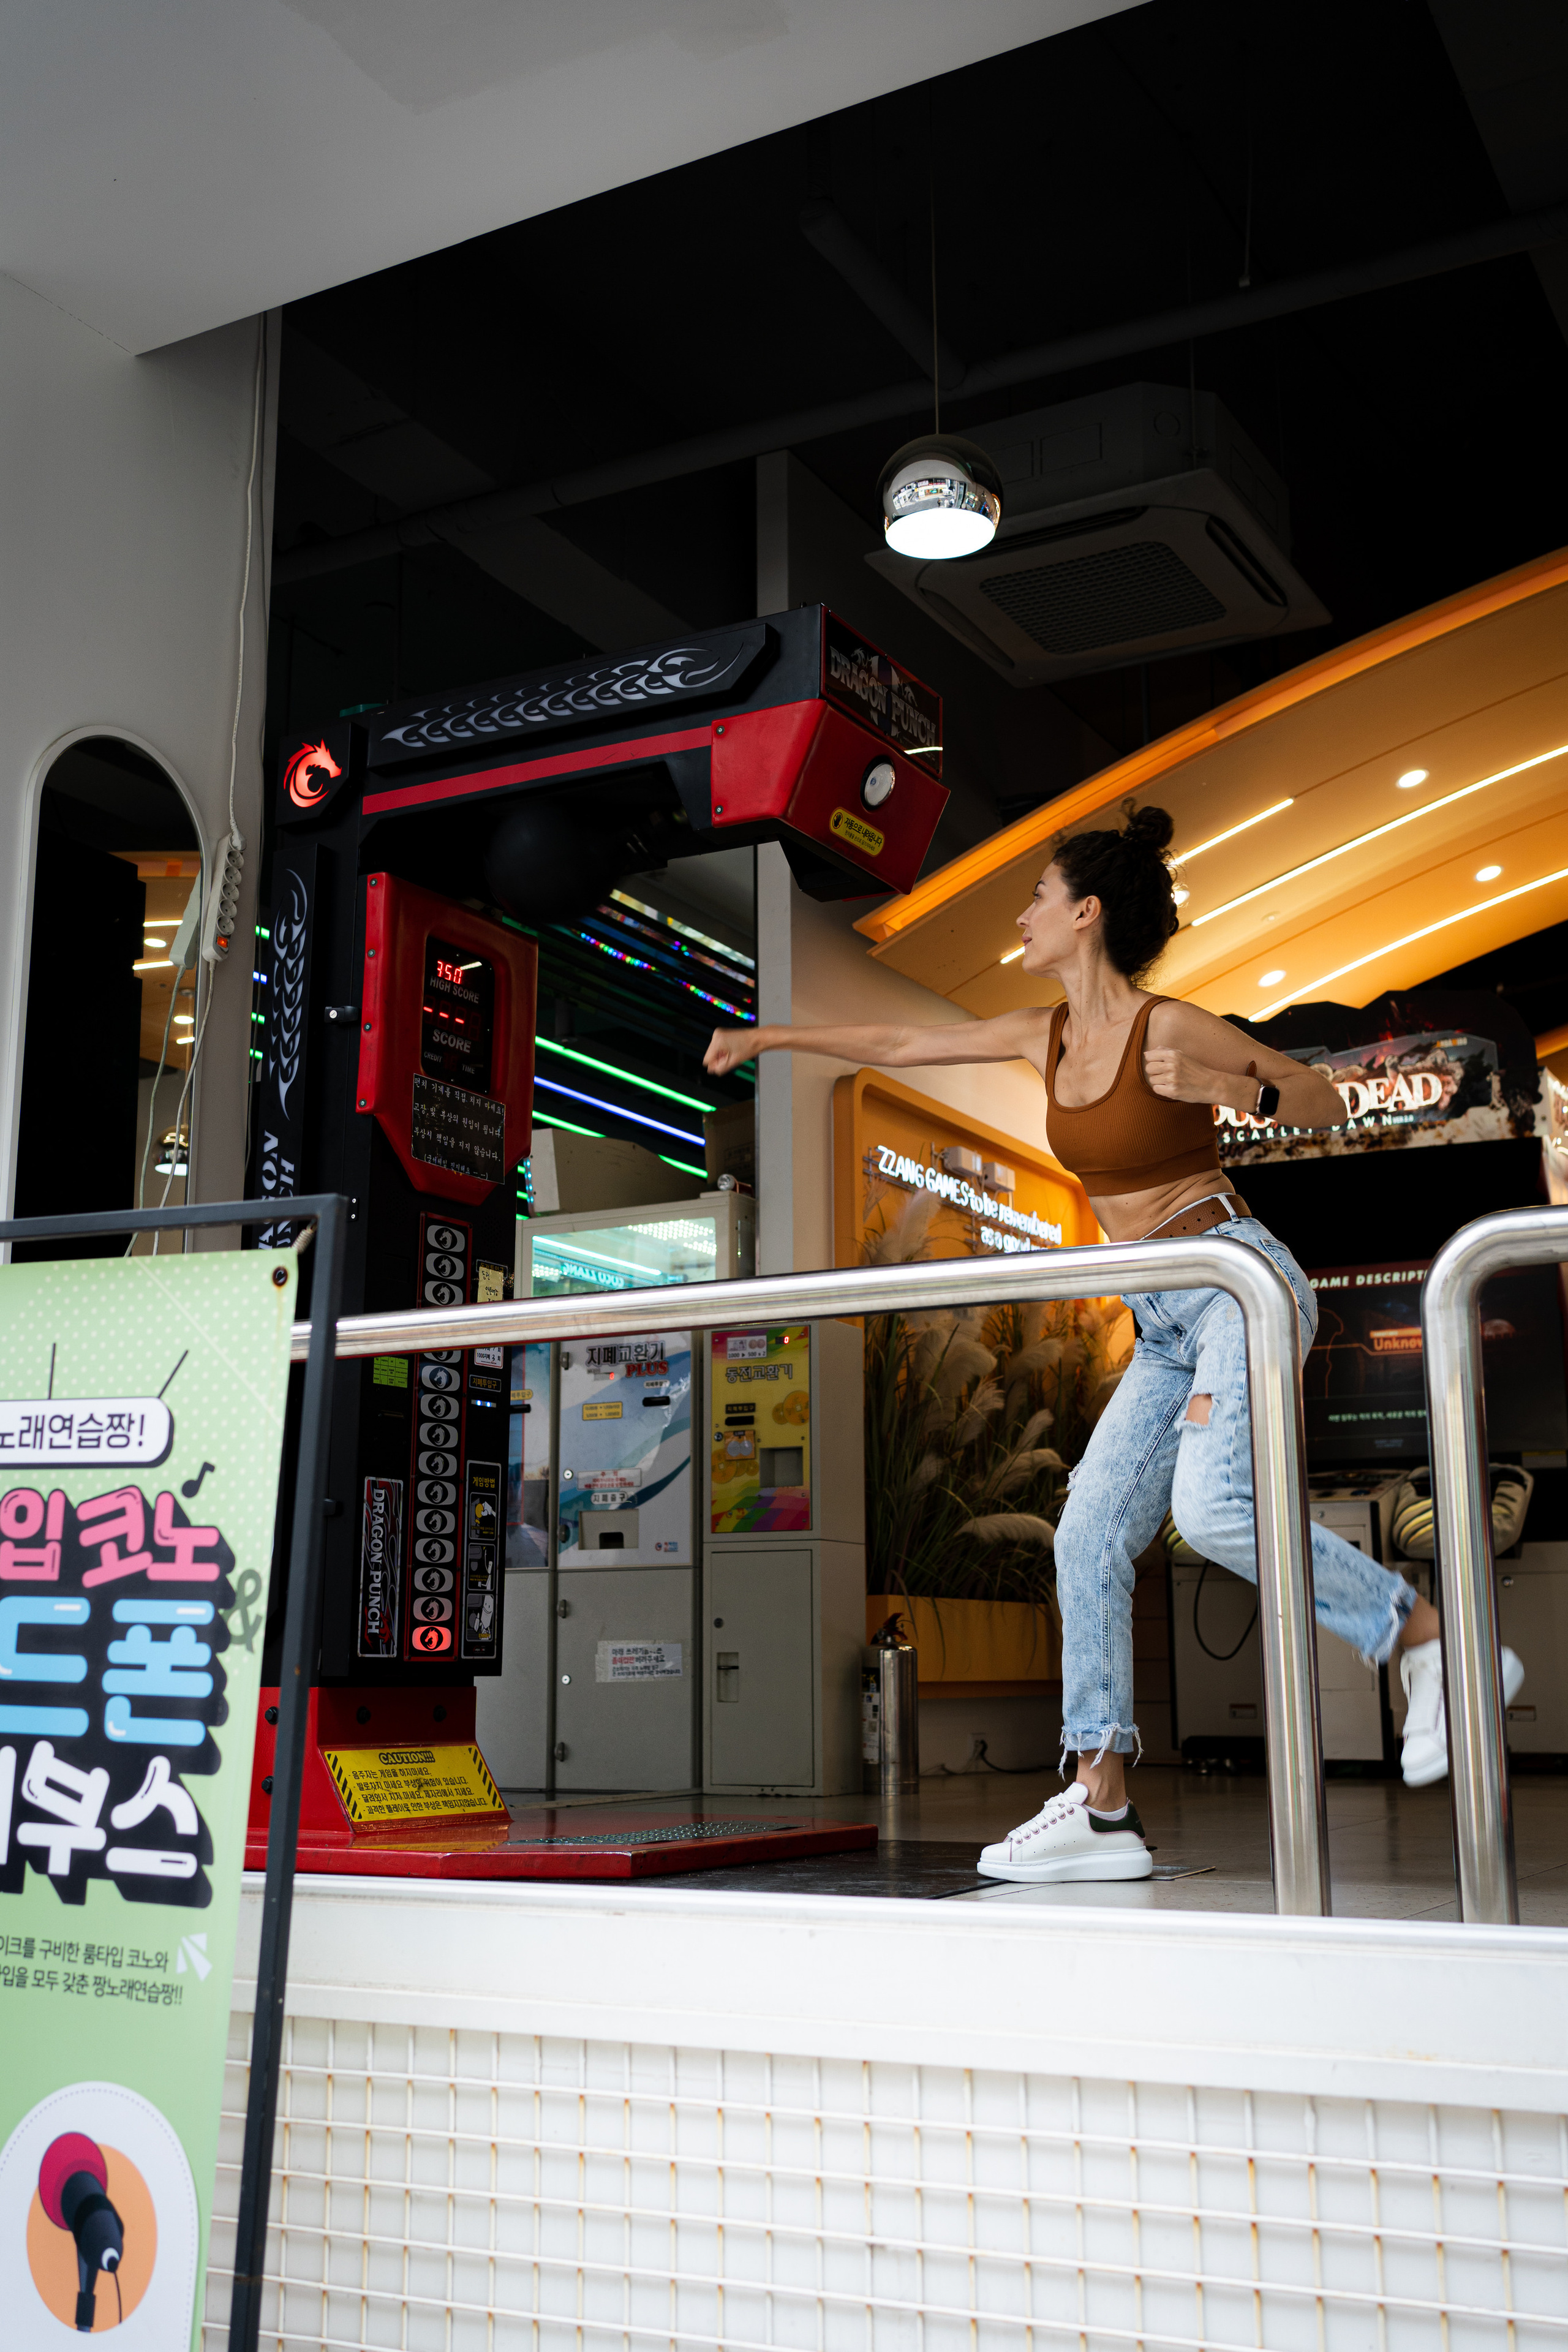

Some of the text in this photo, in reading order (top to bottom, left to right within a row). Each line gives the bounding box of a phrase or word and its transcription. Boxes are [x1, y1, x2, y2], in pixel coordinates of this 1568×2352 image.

[830, 646, 936, 747] DRAGON PUNCH
[845, 818, 883, 847] 자동으로 내려옵니다
[429, 976, 480, 1004] HIGH SCORE
[432, 1029, 472, 1053] SCORE
[424, 1051, 442, 1063] CREDIT
[462, 1063, 475, 1074] TIME
[414, 1077, 504, 1115] 펀치 기계를 직접 치지 마세요!
[1335, 1072, 1442, 1119] DEAD
[414, 1102, 426, 1114] 고장
[430, 1107, 435, 1117] 및
[440, 1109, 458, 1124] 부상의
[483, 1125, 503, 1139] 됩니다.
[414, 1126, 500, 1161] 부상시 책임을 지지 않습니다.
[878, 1145, 924, 1188] ZZANG
[925, 1167, 969, 1206] GAMES
[982, 1191, 998, 1218] be
[998, 1204, 1061, 1245] remembered
[981, 1226, 994, 1246] as
[482, 1271, 490, 1280] 동전
[1309, 1275, 1349, 1289] GAME
[586, 1341, 665, 1366] 지폐교환기
[625, 1361, 669, 1378] PLUS
[726, 1363, 793, 1383] 동전교환기
[472, 1378, 497, 1389] 지폐투입구
[472, 1477, 495, 1488] 게임방법
[368, 1488, 385, 1634] DRAGON PUNCH
[379, 1751, 435, 1765] CAUTION!!!
[352, 1767, 431, 1780] 음주자는 게임을 하지마세요.
[356, 1776, 469, 1791] 발로차지 마세요 부상의 위험이 있습니다.
[361, 1793, 388, 1803] 달려와서
[390, 1792, 402, 1801] 치지
[424, 1789, 454, 1798] 제자리에서
[456, 1787, 474, 1796] 치세요.
[368, 1804, 385, 1815] 과격한
[386, 1803, 410, 1814] 플레이로
[410, 1802, 423, 1812] 인한
[424, 1800, 442, 1811] 부상은
[40, 1939, 80, 1962] 구비한
[83, 1943, 124, 1968] 룸타입
[127, 1949, 168, 1973] 코노와
[0, 1966, 183, 2005] 입을 모두 갖춘 짱노래연습짱!!
